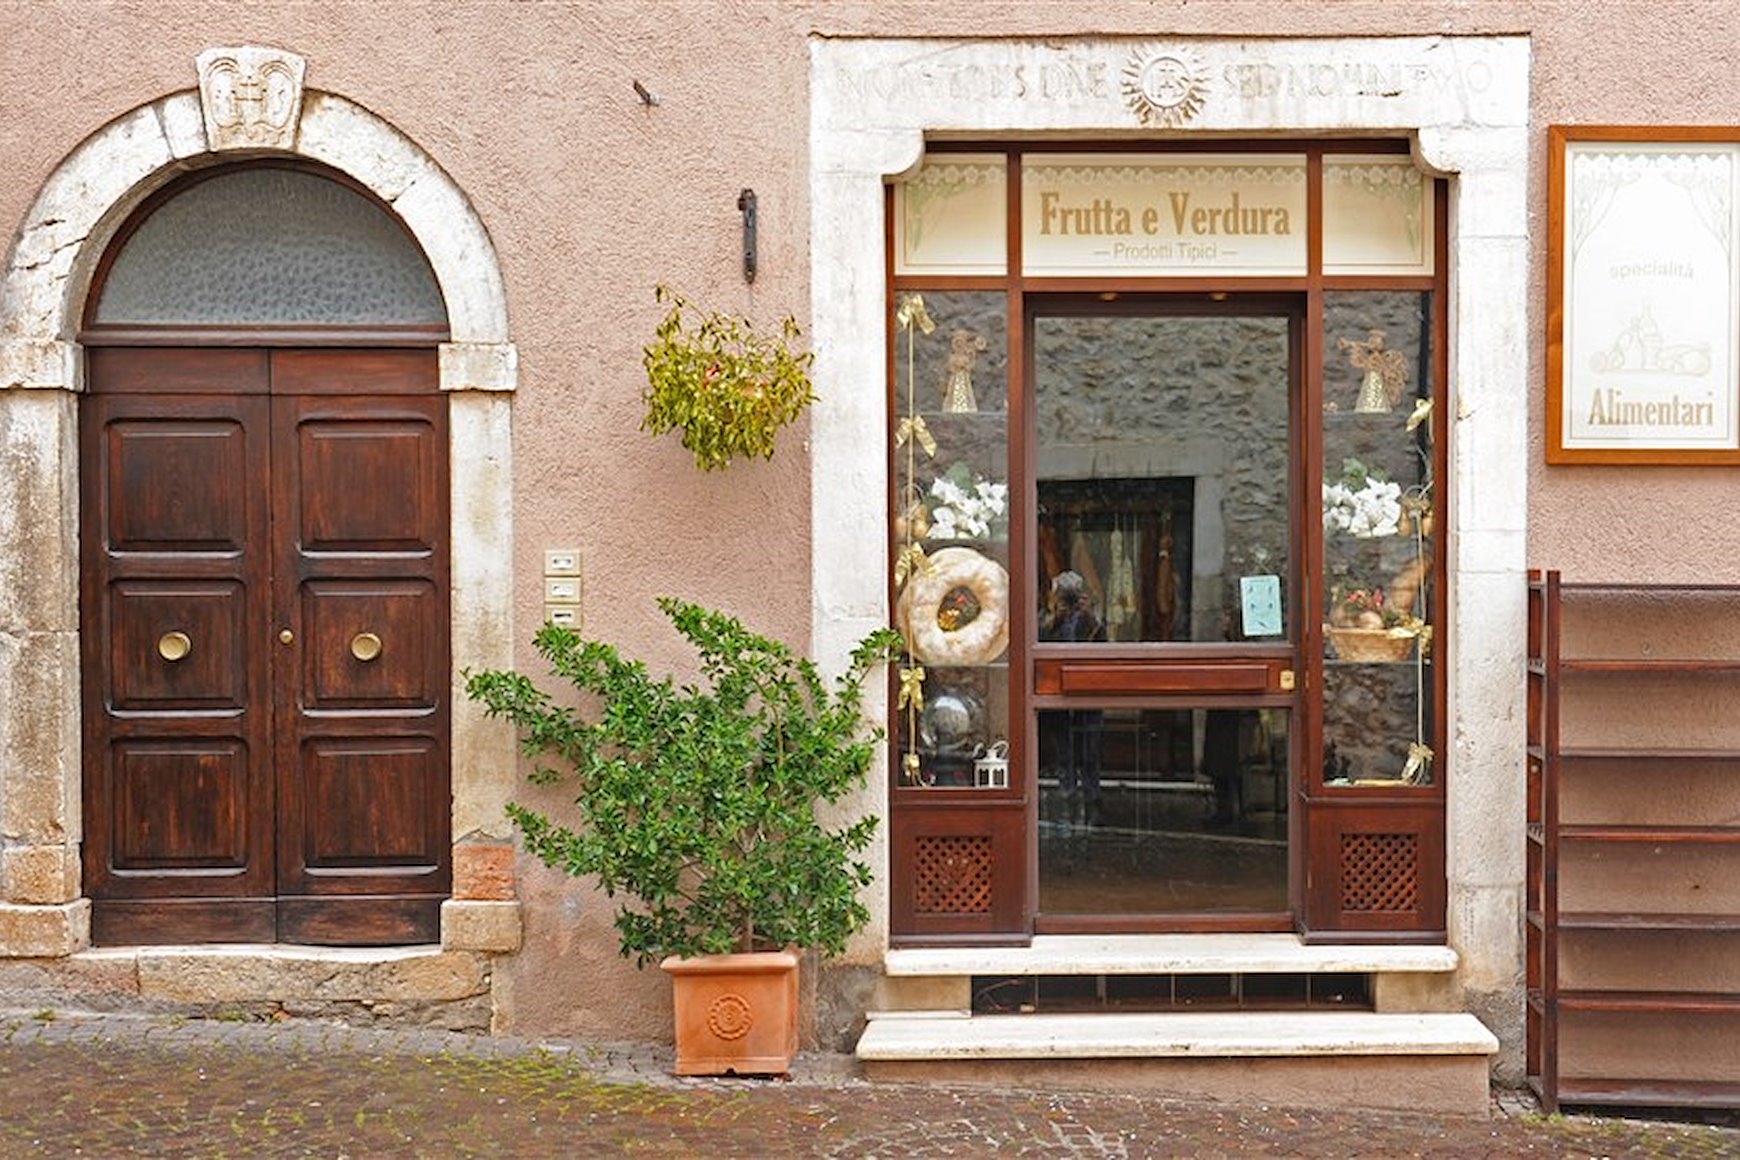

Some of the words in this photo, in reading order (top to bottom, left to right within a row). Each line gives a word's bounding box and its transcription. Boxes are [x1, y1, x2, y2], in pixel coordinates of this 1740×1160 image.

[1039, 191, 1132, 235] Frutta
[1141, 206, 1158, 235] e
[1168, 191, 1291, 235] Verdura
[1113, 242, 1172, 260] Prodotti
[1176, 242, 1217, 262] Tipici
[1608, 260, 1695, 280] specialità
[1588, 387, 1714, 426] Alimentari
